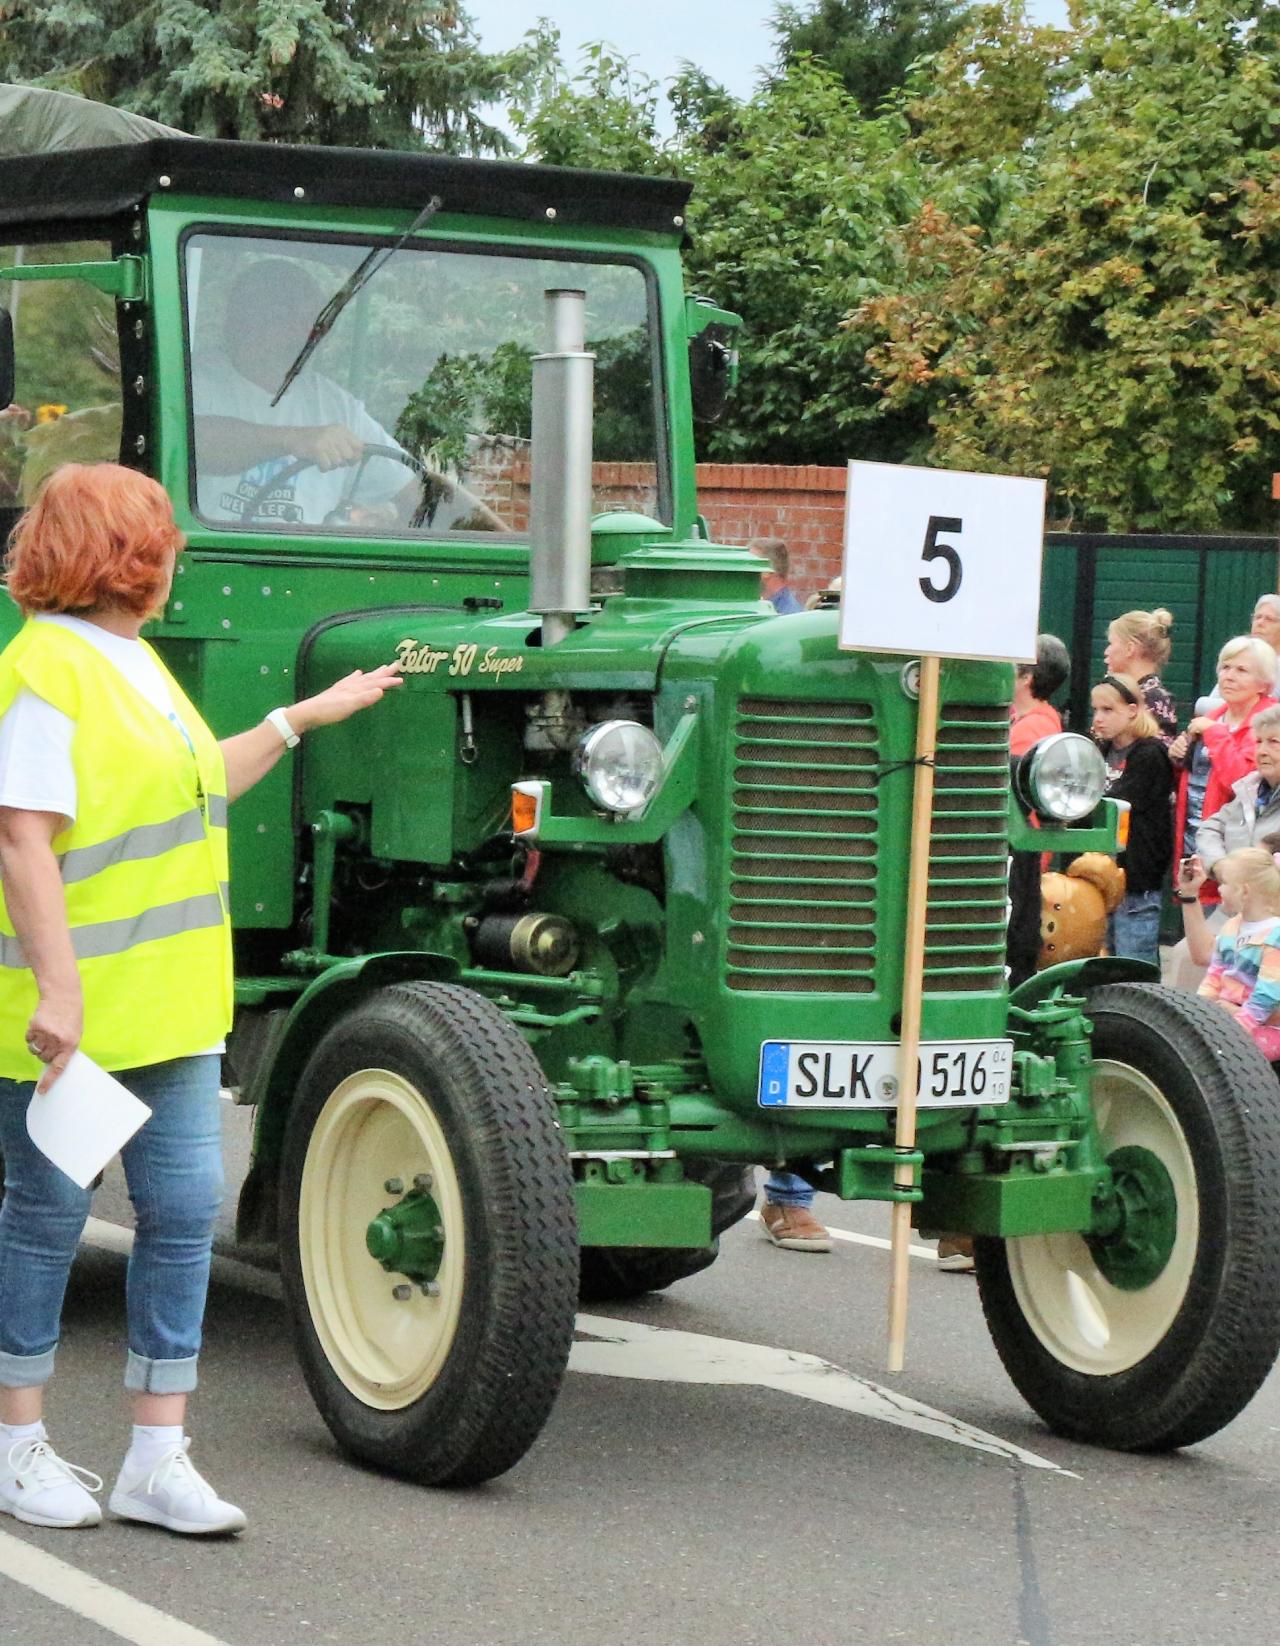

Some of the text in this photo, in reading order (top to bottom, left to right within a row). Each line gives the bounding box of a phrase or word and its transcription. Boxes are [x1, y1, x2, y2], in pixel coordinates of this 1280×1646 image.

[919, 515, 963, 603] 5
[448, 643, 478, 676] 50
[478, 645, 523, 683] Super
[770, 1081, 780, 1095] D
[795, 1052, 874, 1099] SLK
[932, 1051, 986, 1096] 516
